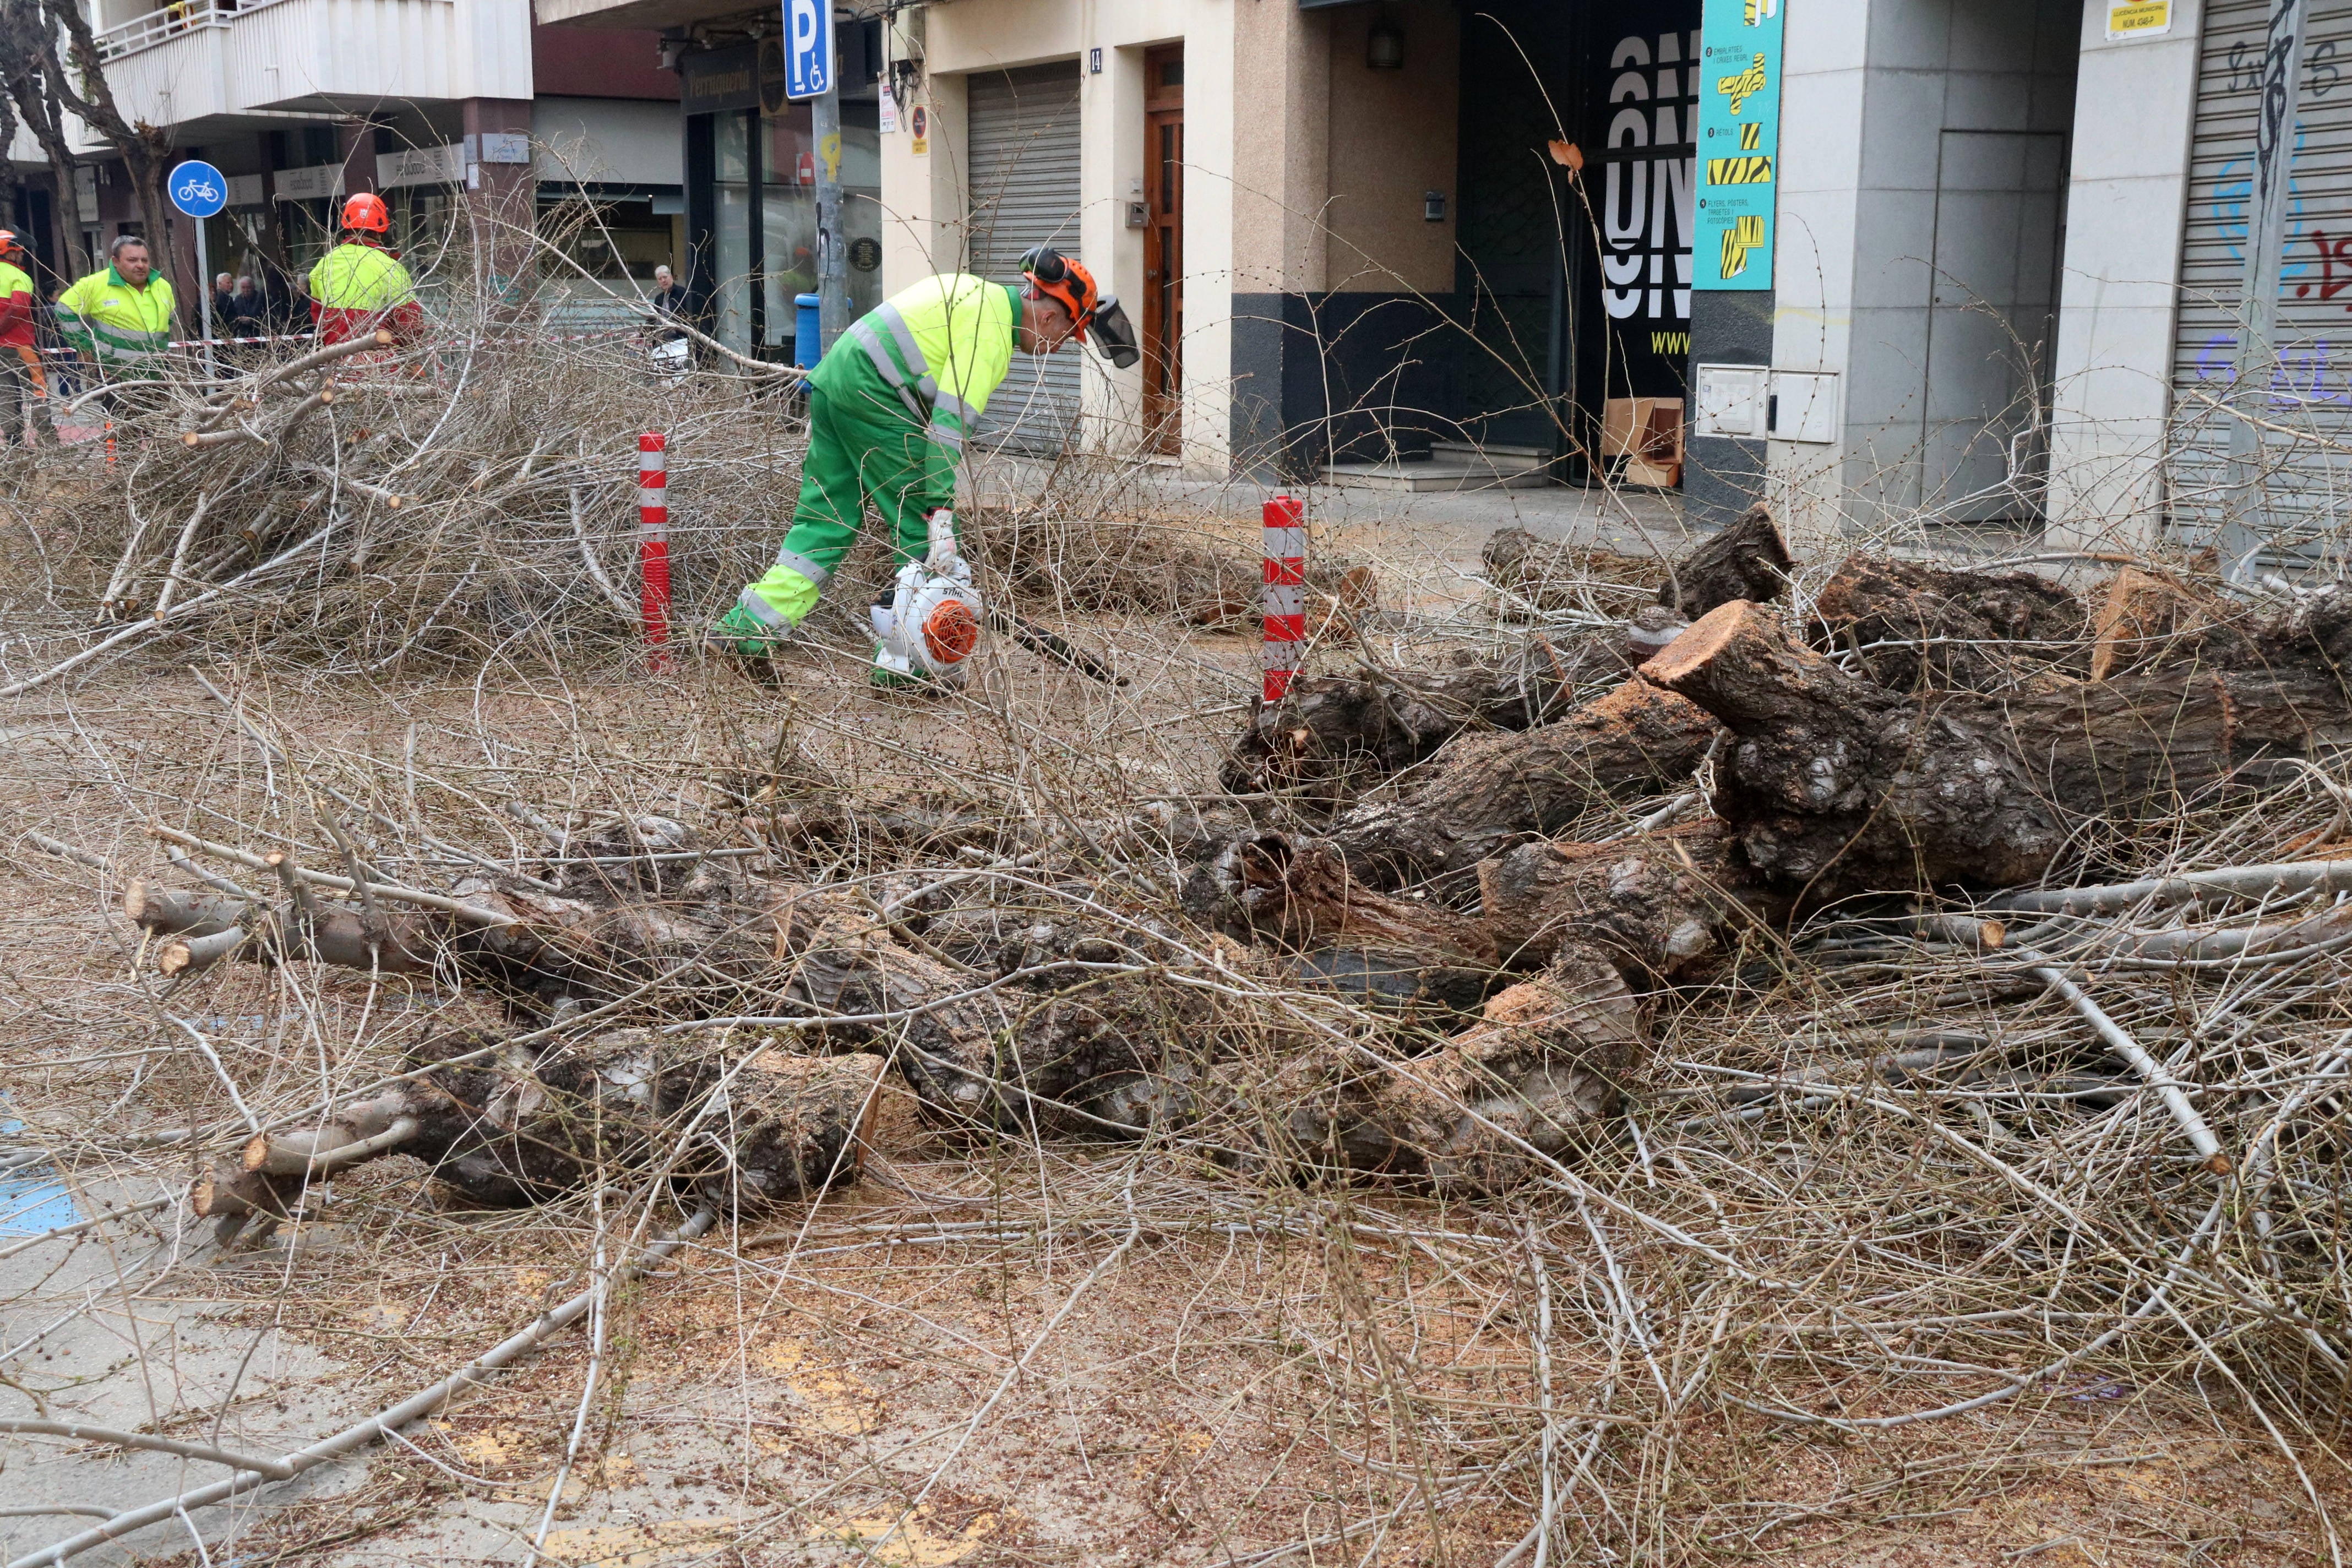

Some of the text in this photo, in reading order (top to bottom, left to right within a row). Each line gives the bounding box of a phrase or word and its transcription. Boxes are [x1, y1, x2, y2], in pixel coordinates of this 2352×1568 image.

[791, 0, 817, 83] P
[1713, 45, 1743, 56] EMBALATGES
[1734, 54, 1748, 62] REGAL
[1092, 50, 1100, 70] 14
[689, 63, 750, 103] Perruqueria
[943, 587, 963, 598] STIHL
